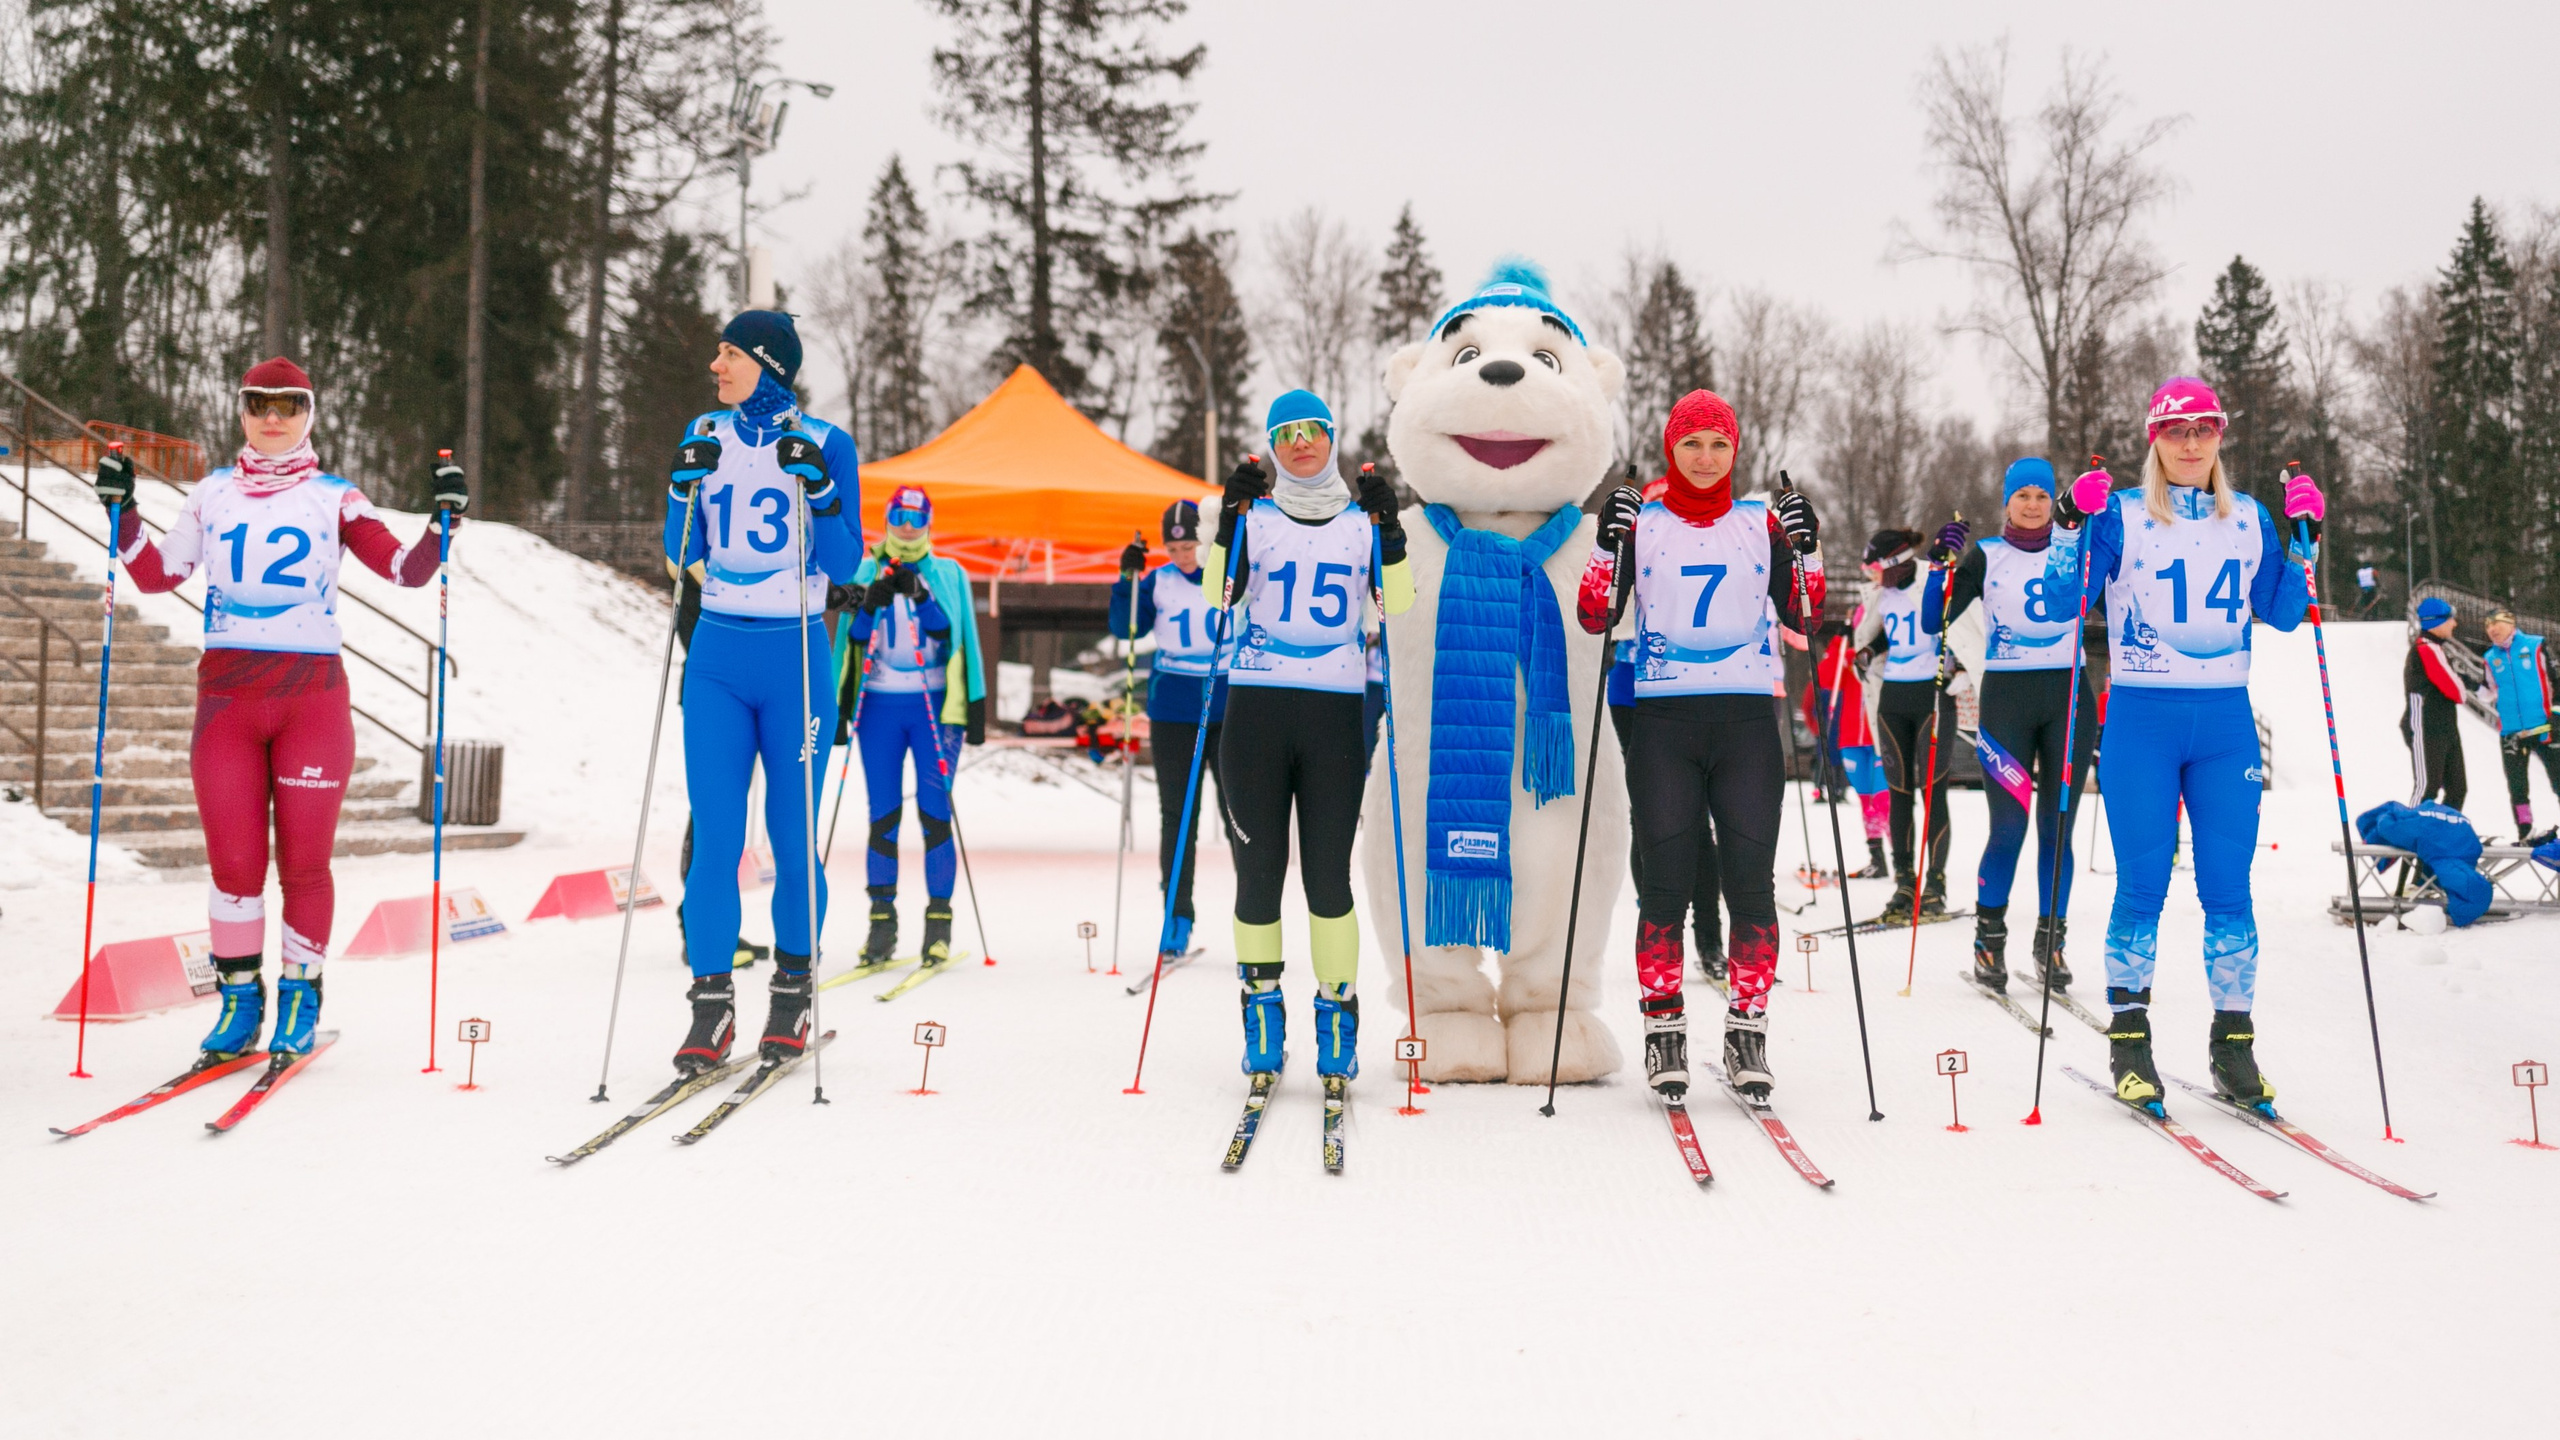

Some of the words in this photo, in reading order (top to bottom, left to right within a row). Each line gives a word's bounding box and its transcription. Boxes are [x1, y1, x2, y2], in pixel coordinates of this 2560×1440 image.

[763, 353, 785, 375] odlo
[709, 484, 790, 554] 13
[220, 523, 311, 588] 12
[1613, 540, 1624, 587] MADSHUS
[1794, 549, 1807, 596] MADSHUS
[1268, 561, 1352, 628] 15
[1681, 564, 1727, 628] 7
[2156, 559, 2245, 623] 14
[2303, 559, 2318, 597] KV+
[2024, 577, 2050, 623] 8
[1169, 608, 1234, 648] 10
[1885, 610, 1916, 646] 21
[278, 776, 340, 788] NORDSKI
[1464, 838, 1496, 849] ГАЗПРОМ
[1803, 939, 1811, 950] 7
[469, 1025, 479, 1039] 5
[711, 1009, 733, 1047] MADSHUS
[924, 1028, 934, 1042] 4
[1406, 1043, 1415, 1057] 3
[1947, 1056, 1957, 1071] 2
[2526, 1068, 2534, 1082] 1
[1683, 1147, 1706, 1171] MADSHUS
